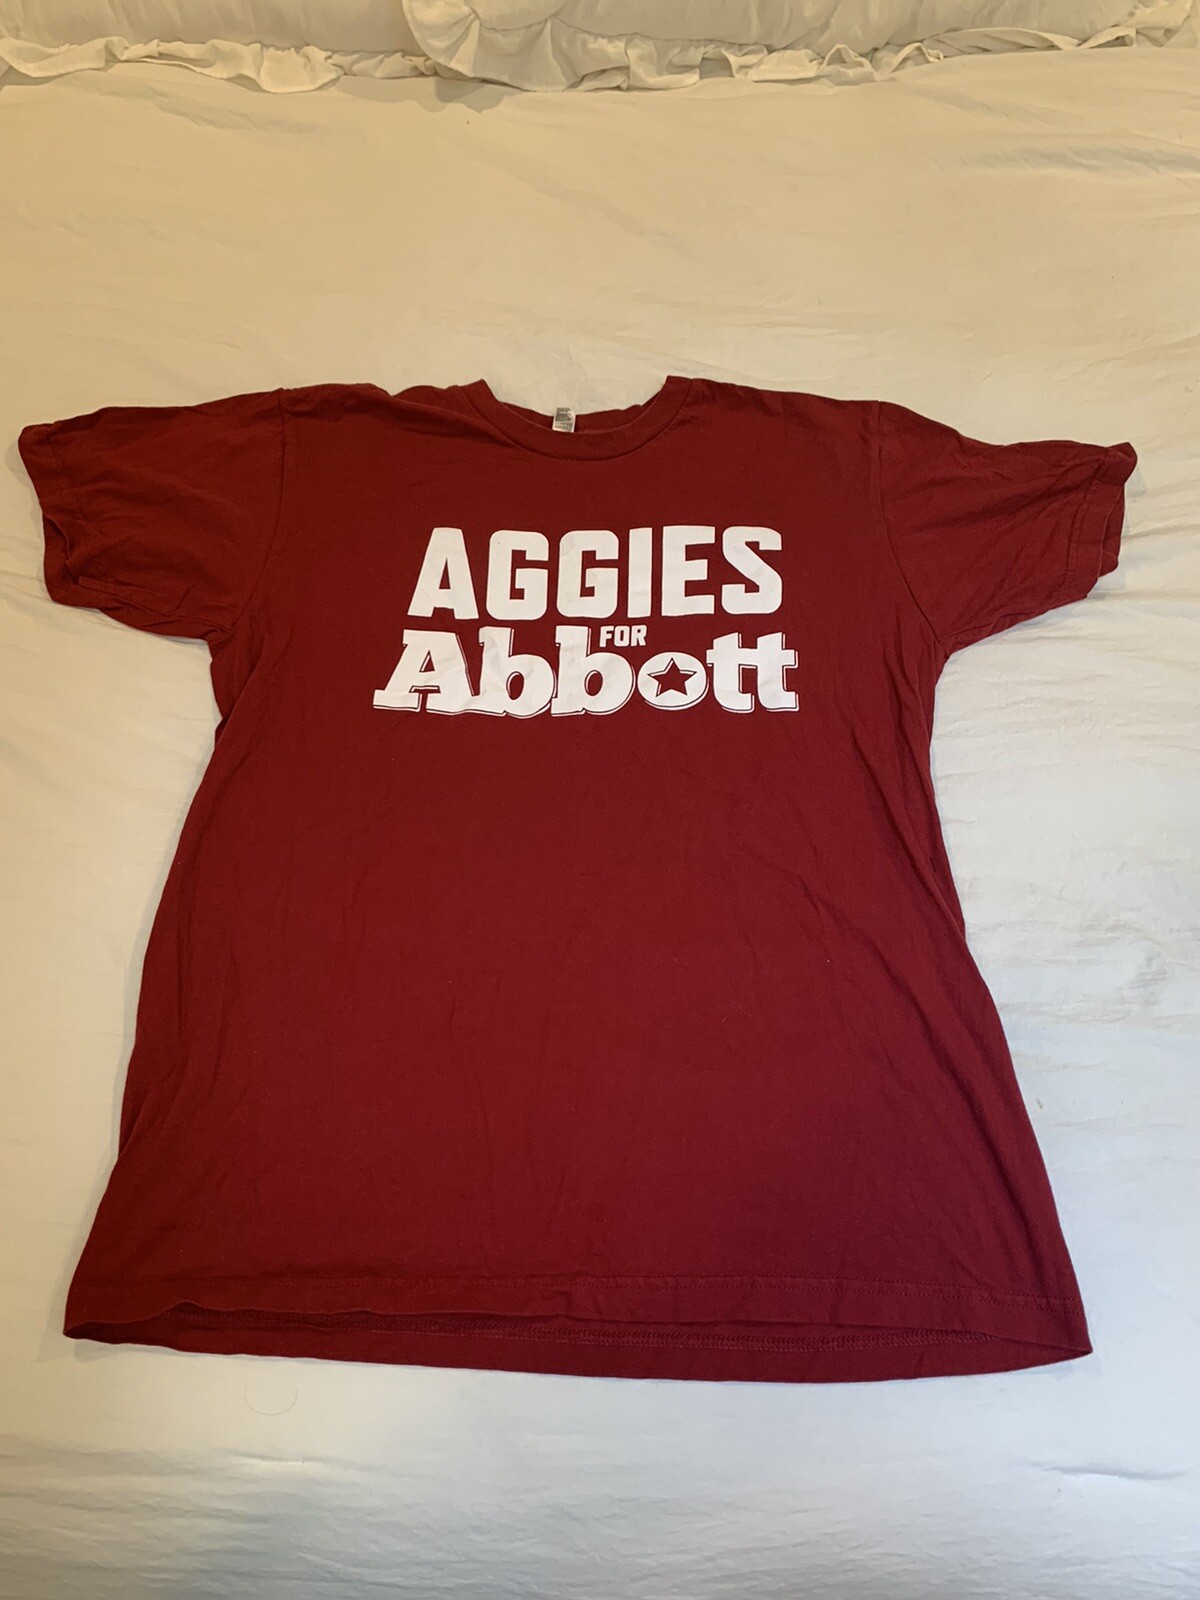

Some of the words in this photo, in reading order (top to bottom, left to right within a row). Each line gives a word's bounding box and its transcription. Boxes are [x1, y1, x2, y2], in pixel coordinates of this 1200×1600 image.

[407, 525, 783, 620] AGGIES
[373, 625, 799, 719] Abbott
[599, 625, 648, 648] FOR
